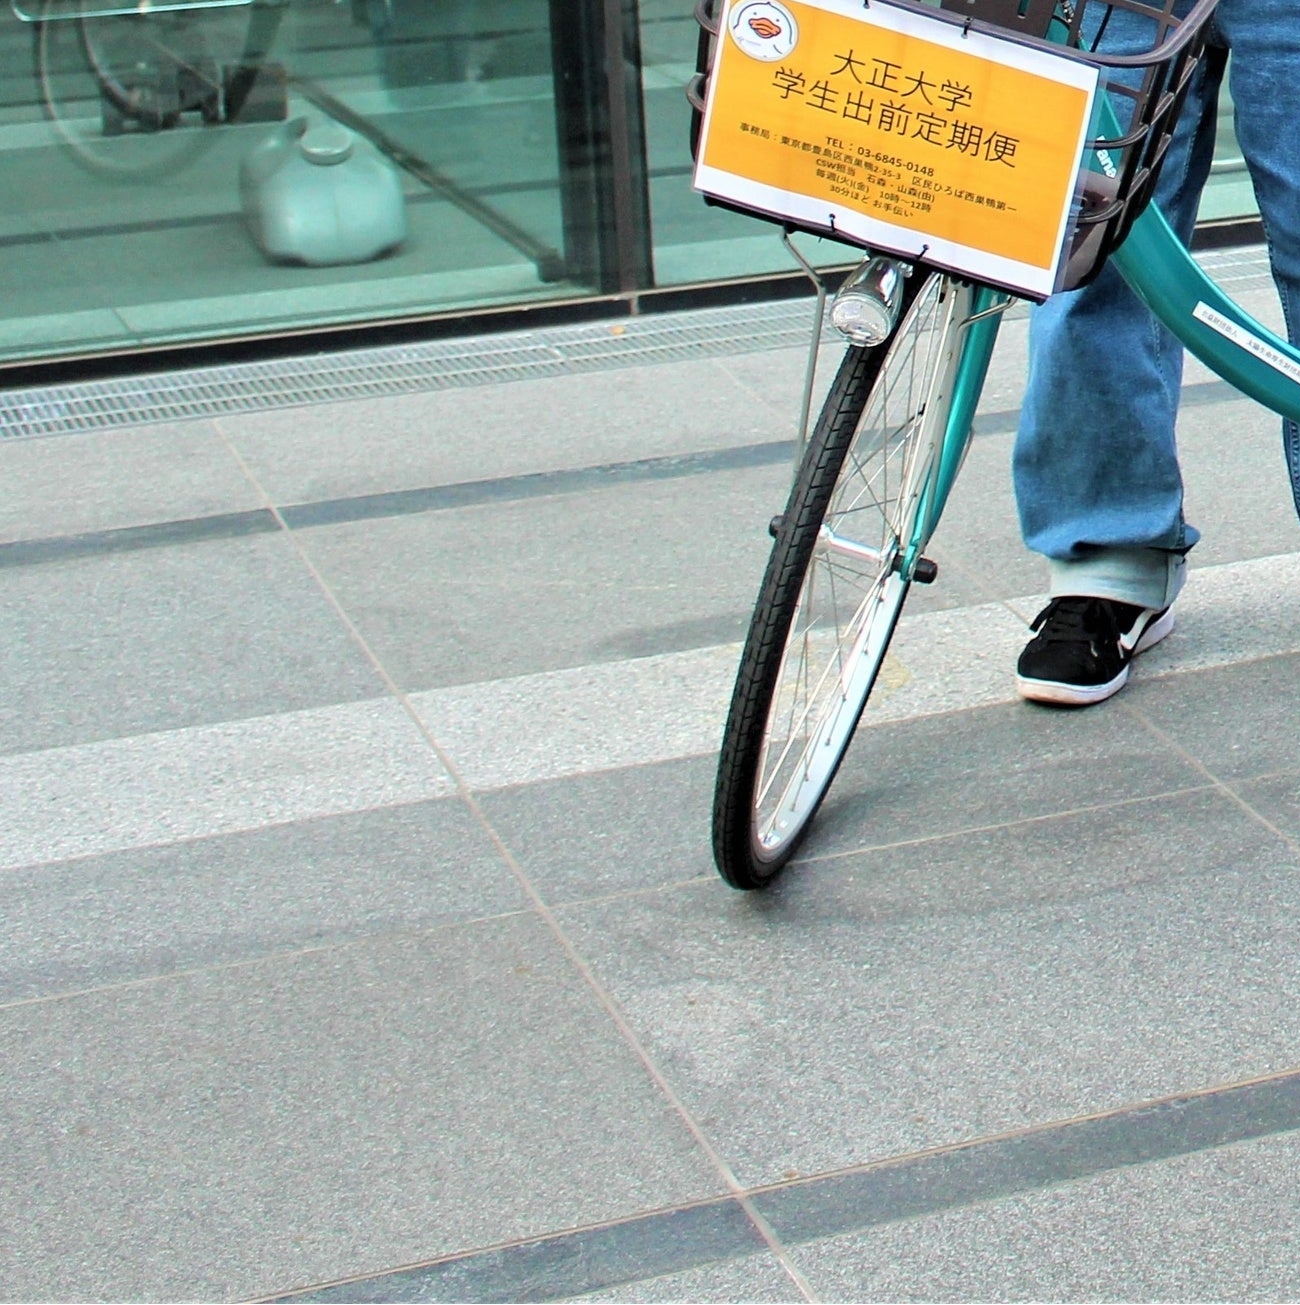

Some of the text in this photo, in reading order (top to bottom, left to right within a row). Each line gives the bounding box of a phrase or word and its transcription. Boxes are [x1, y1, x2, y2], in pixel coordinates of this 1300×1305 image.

[830, 49, 973, 112] 大正大学
[771, 66, 1020, 168] 学生出前定期便
[816, 158, 856, 177] CSW担当
[829, 185, 914, 218] 30分ほど お手伝い
